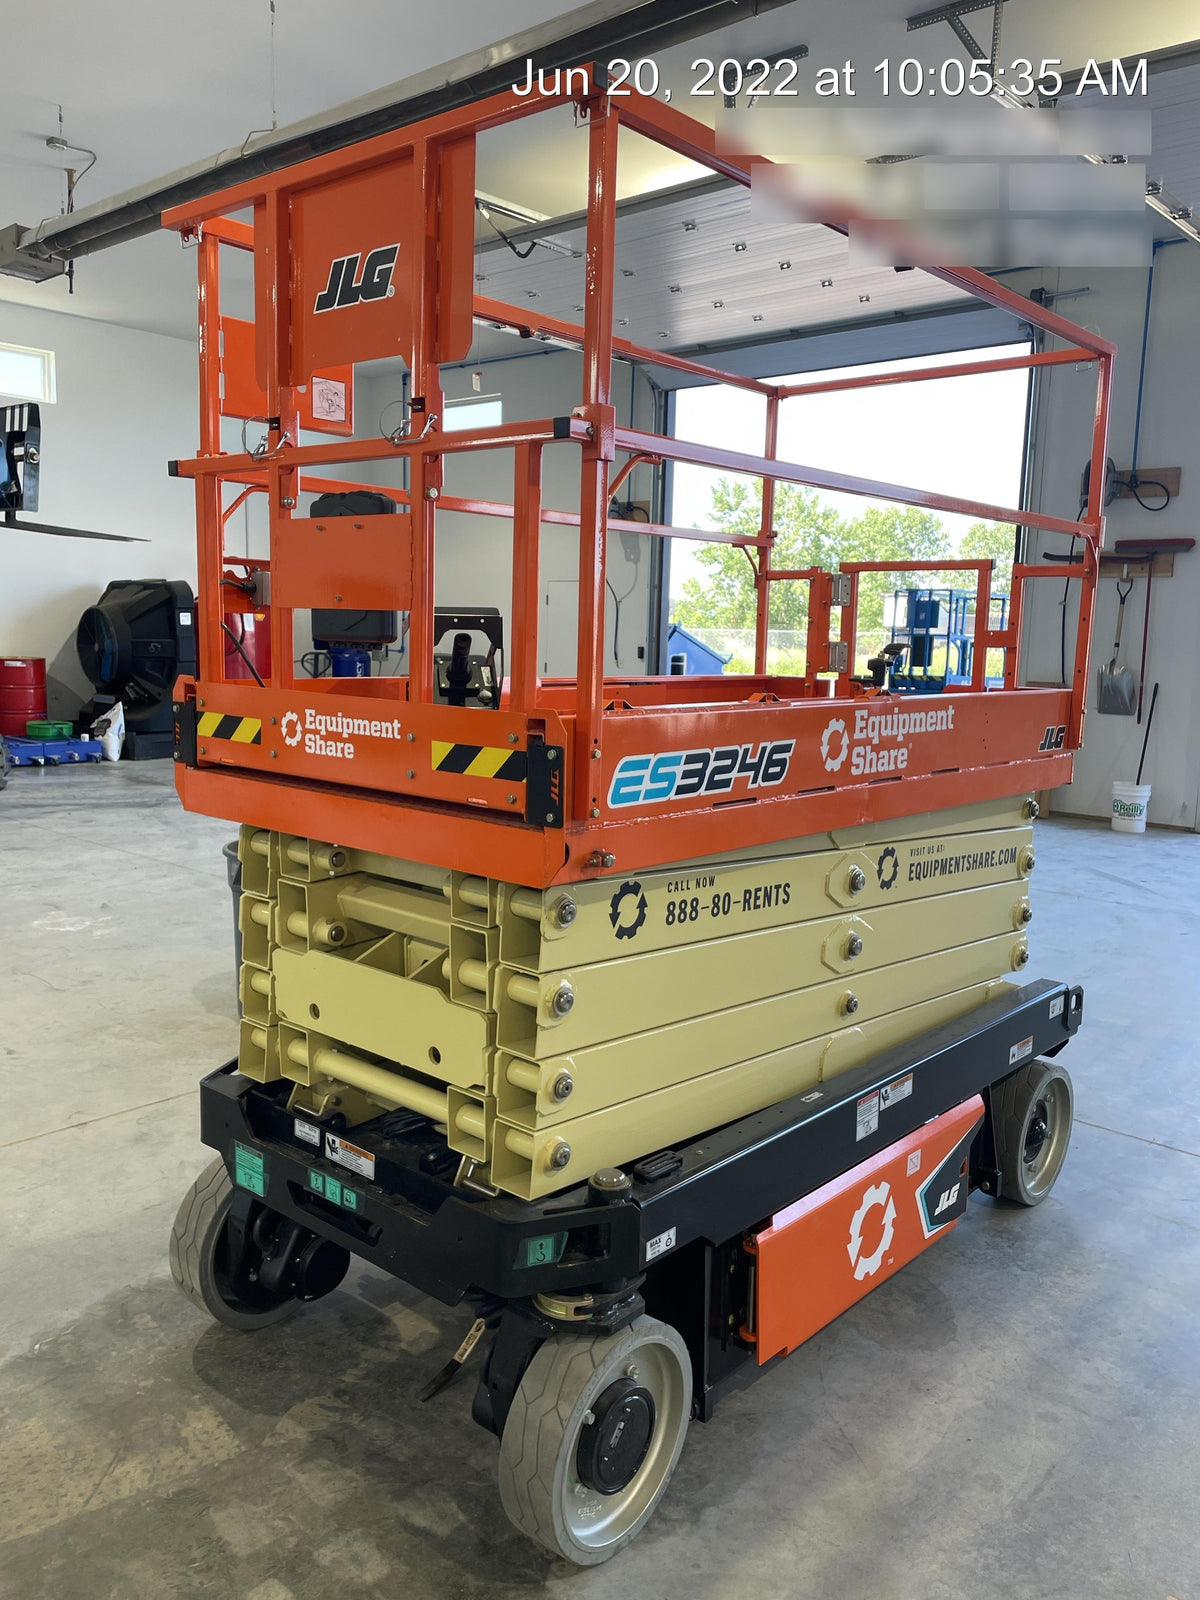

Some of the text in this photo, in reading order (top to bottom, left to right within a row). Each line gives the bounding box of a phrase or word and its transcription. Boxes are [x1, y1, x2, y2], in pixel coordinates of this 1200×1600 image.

[313, 243, 401, 314] JLG
[305, 709, 401, 739] Equipment
[853, 705, 956, 744] Equipment
[1038, 725, 1067, 752] JLG
[305, 733, 354, 759] Share
[851, 745, 908, 775] Share
[550, 767, 560, 807] JLG
[608, 739, 796, 808] ES3246
[908, 847, 1018, 882] EQUIPMENTSHARE.COM
[910, 847, 926, 857] VISIT
[927, 846, 936, 855] US
[667, 876, 716, 893] CALL NOW
[665, 882, 791, 926] 888-80-RENTS
[934, 1182, 961, 1216] JLG
